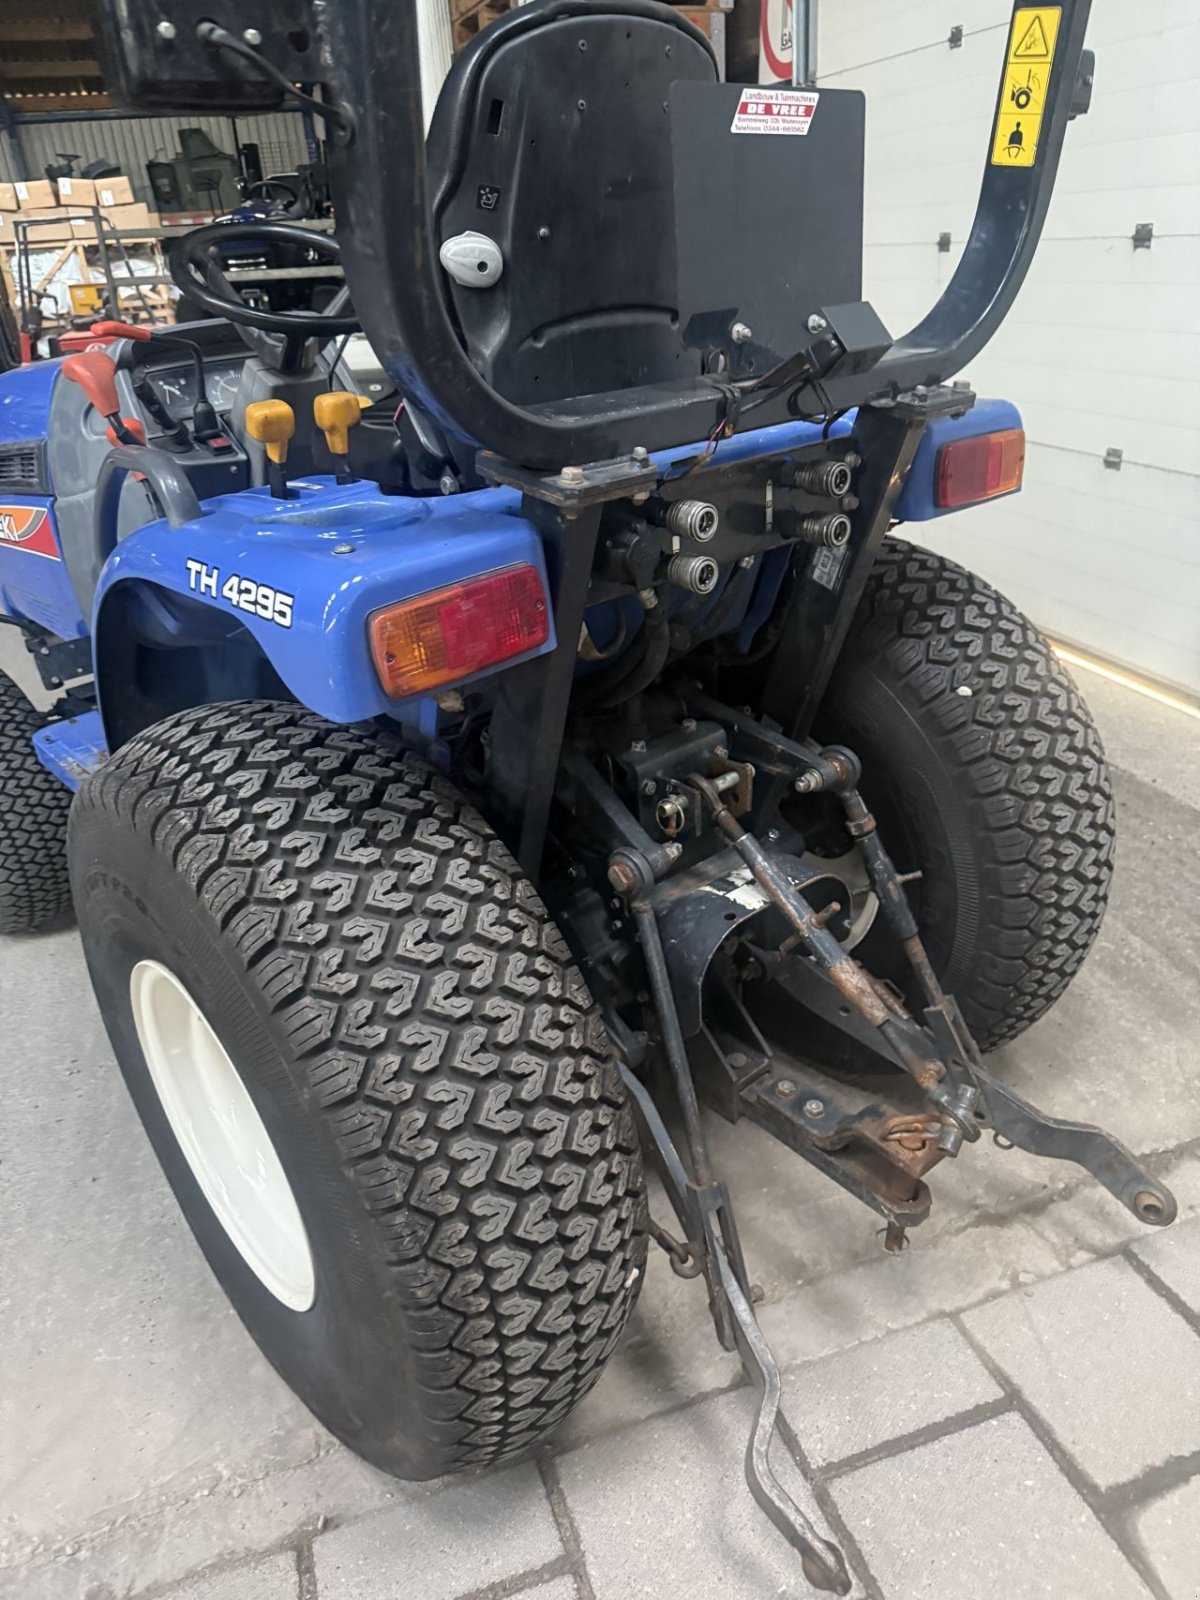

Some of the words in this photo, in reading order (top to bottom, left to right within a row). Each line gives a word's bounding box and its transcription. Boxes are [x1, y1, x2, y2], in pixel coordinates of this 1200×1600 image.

[746, 103, 766, 114] DE
[771, 104, 806, 116] VREE
[186, 557, 219, 599] TH
[222, 573, 295, 629] 4295
